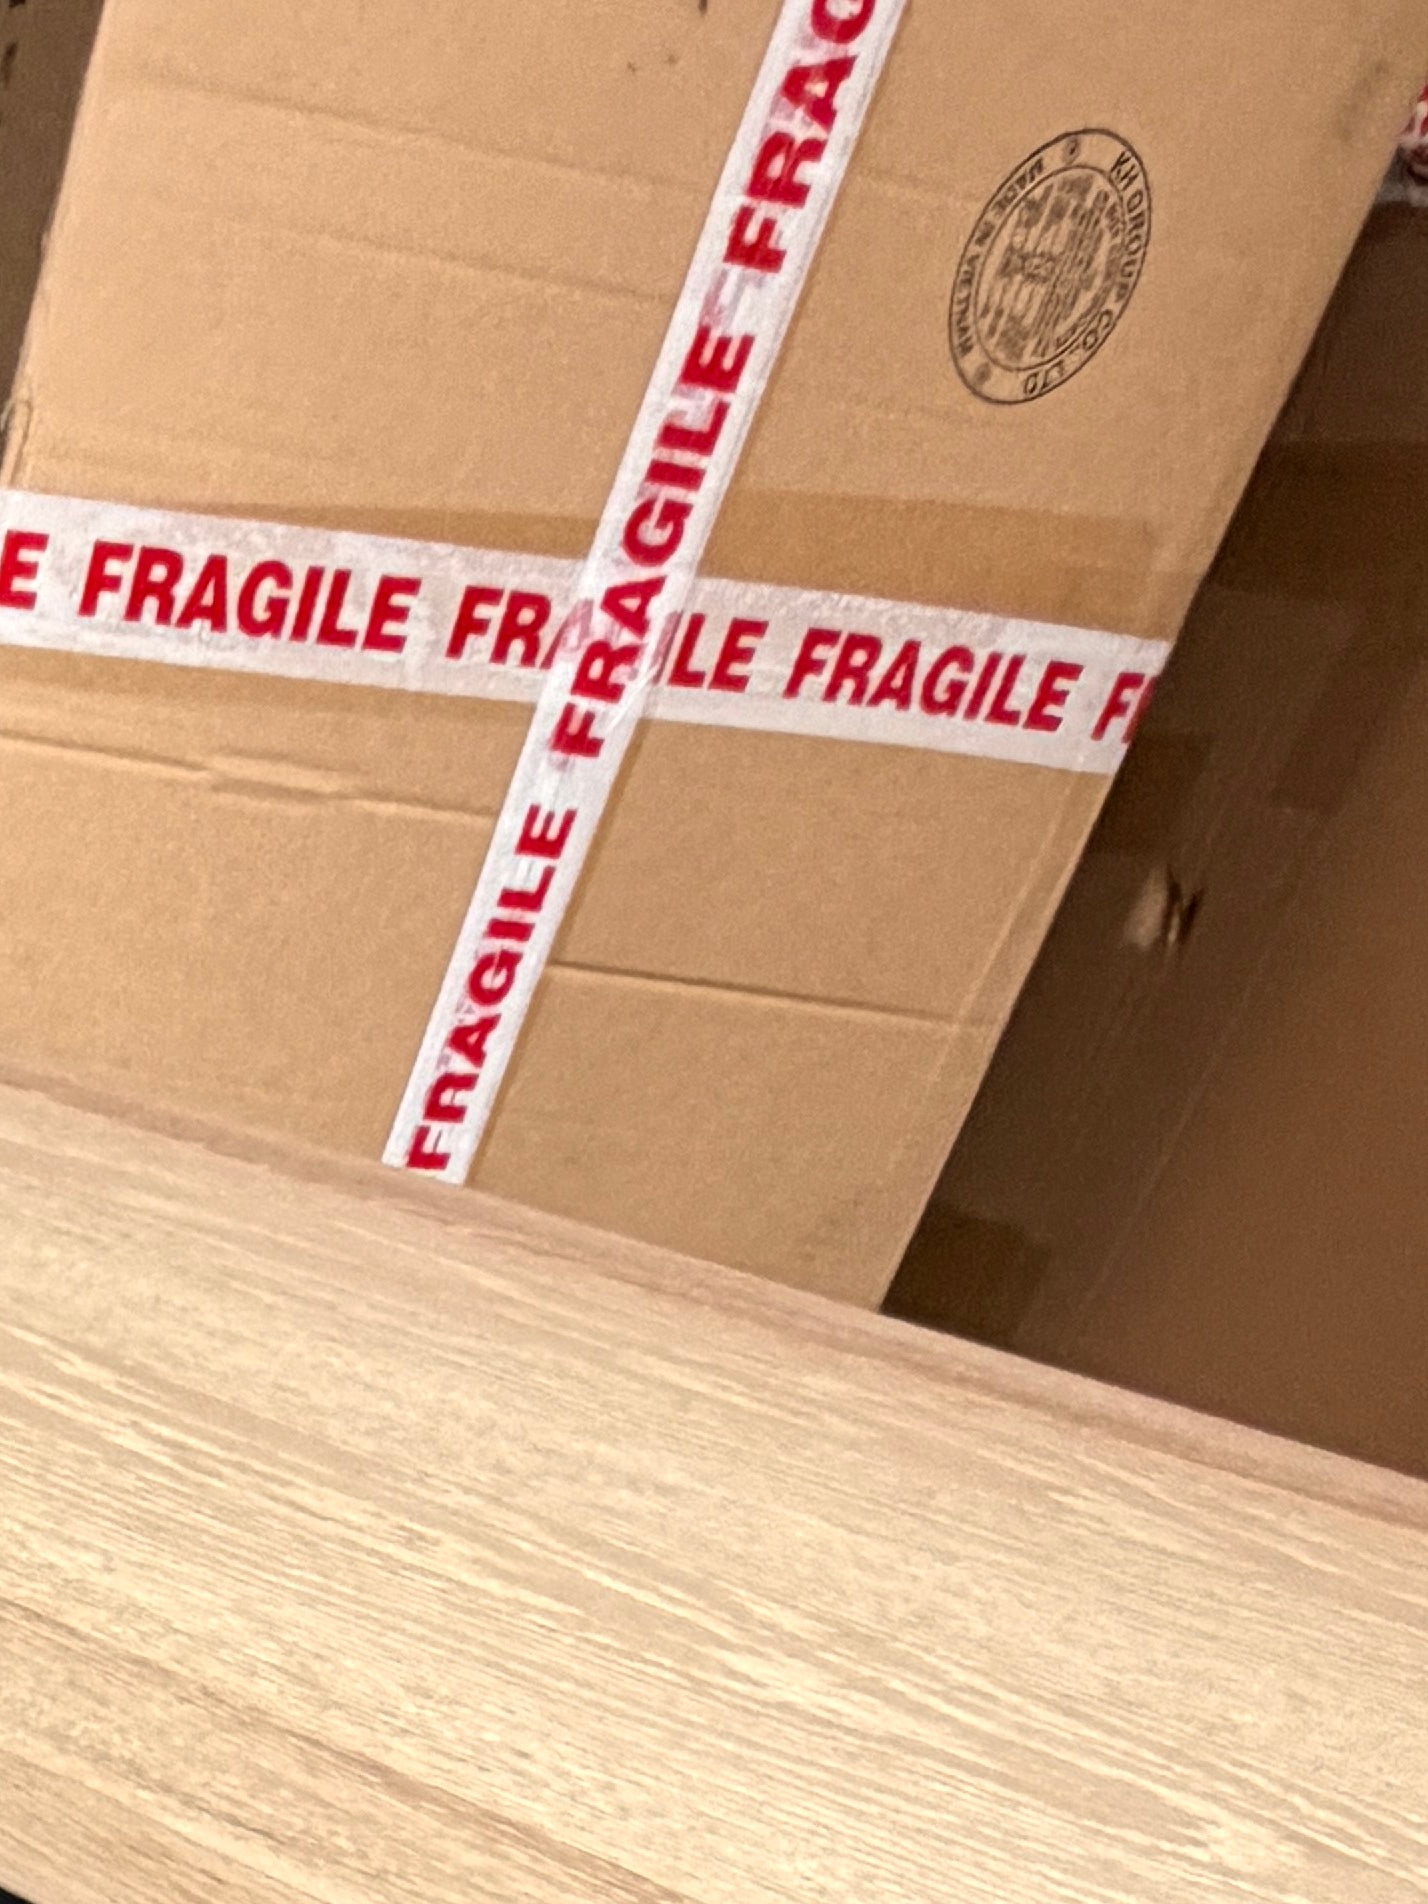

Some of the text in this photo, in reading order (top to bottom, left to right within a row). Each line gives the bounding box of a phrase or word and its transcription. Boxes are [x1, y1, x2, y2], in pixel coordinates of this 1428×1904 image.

[77, 539, 422, 655] FRAGILE
[781, 626, 1084, 733] FRAGILE
[405, 803, 577, 1172] FRAGILE
[548, 325, 756, 760] FRAGILE
